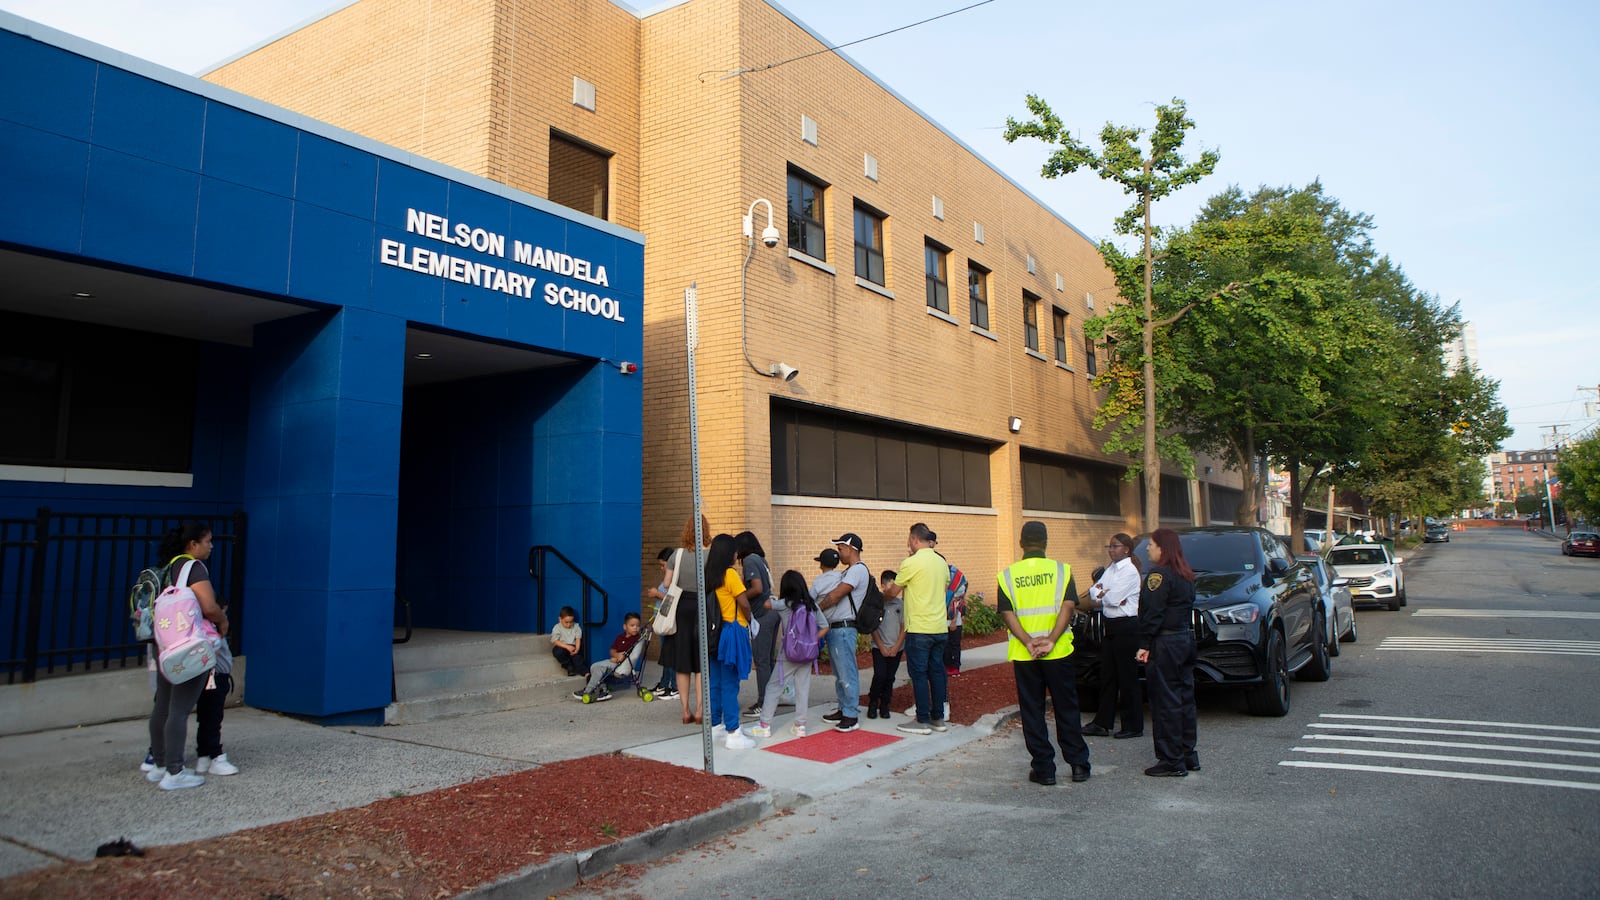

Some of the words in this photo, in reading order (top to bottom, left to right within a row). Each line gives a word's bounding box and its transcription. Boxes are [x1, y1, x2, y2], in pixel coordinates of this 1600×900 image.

[380, 239, 536, 299] ELEMENTARY
[543, 283, 625, 323] SCHOOL
[406, 208, 504, 257] NELSON
[514, 240, 609, 287] MANDELA
[1015, 573, 1054, 588] SECURITY
